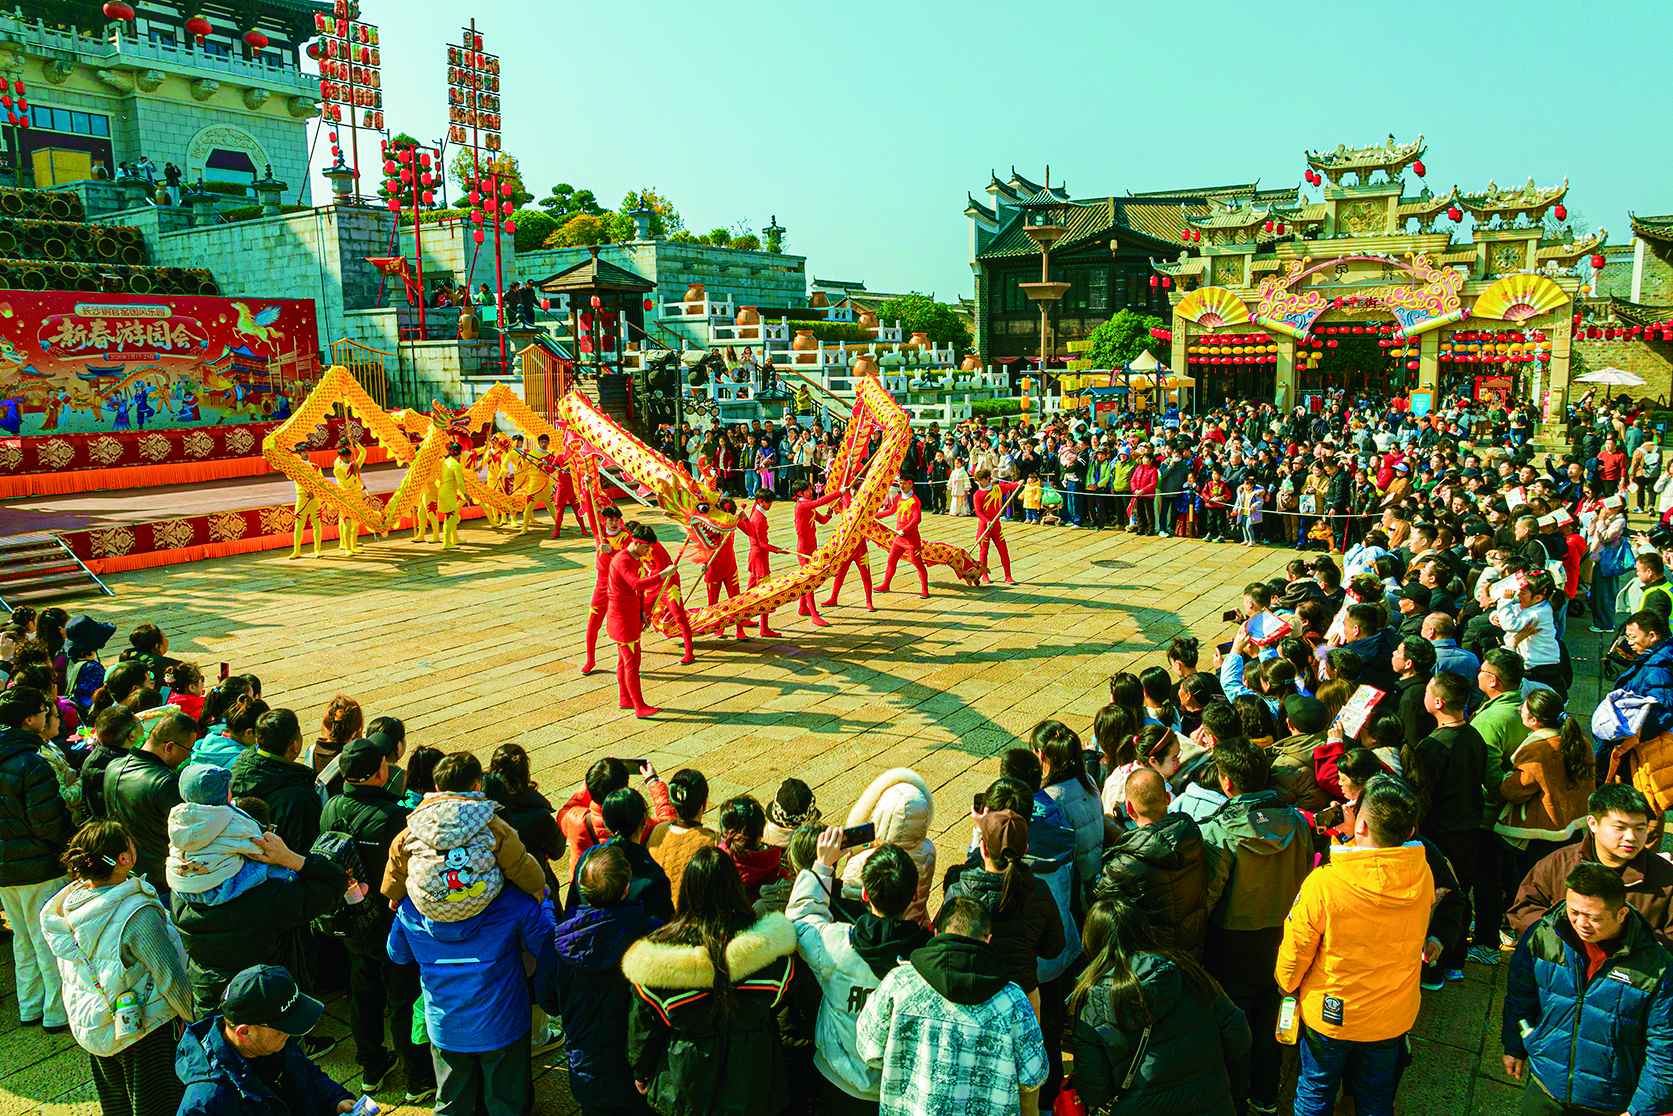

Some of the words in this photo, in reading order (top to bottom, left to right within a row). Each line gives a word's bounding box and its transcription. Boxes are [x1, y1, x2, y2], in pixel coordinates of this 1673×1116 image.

[49, 318, 201, 351] 新春游园会
